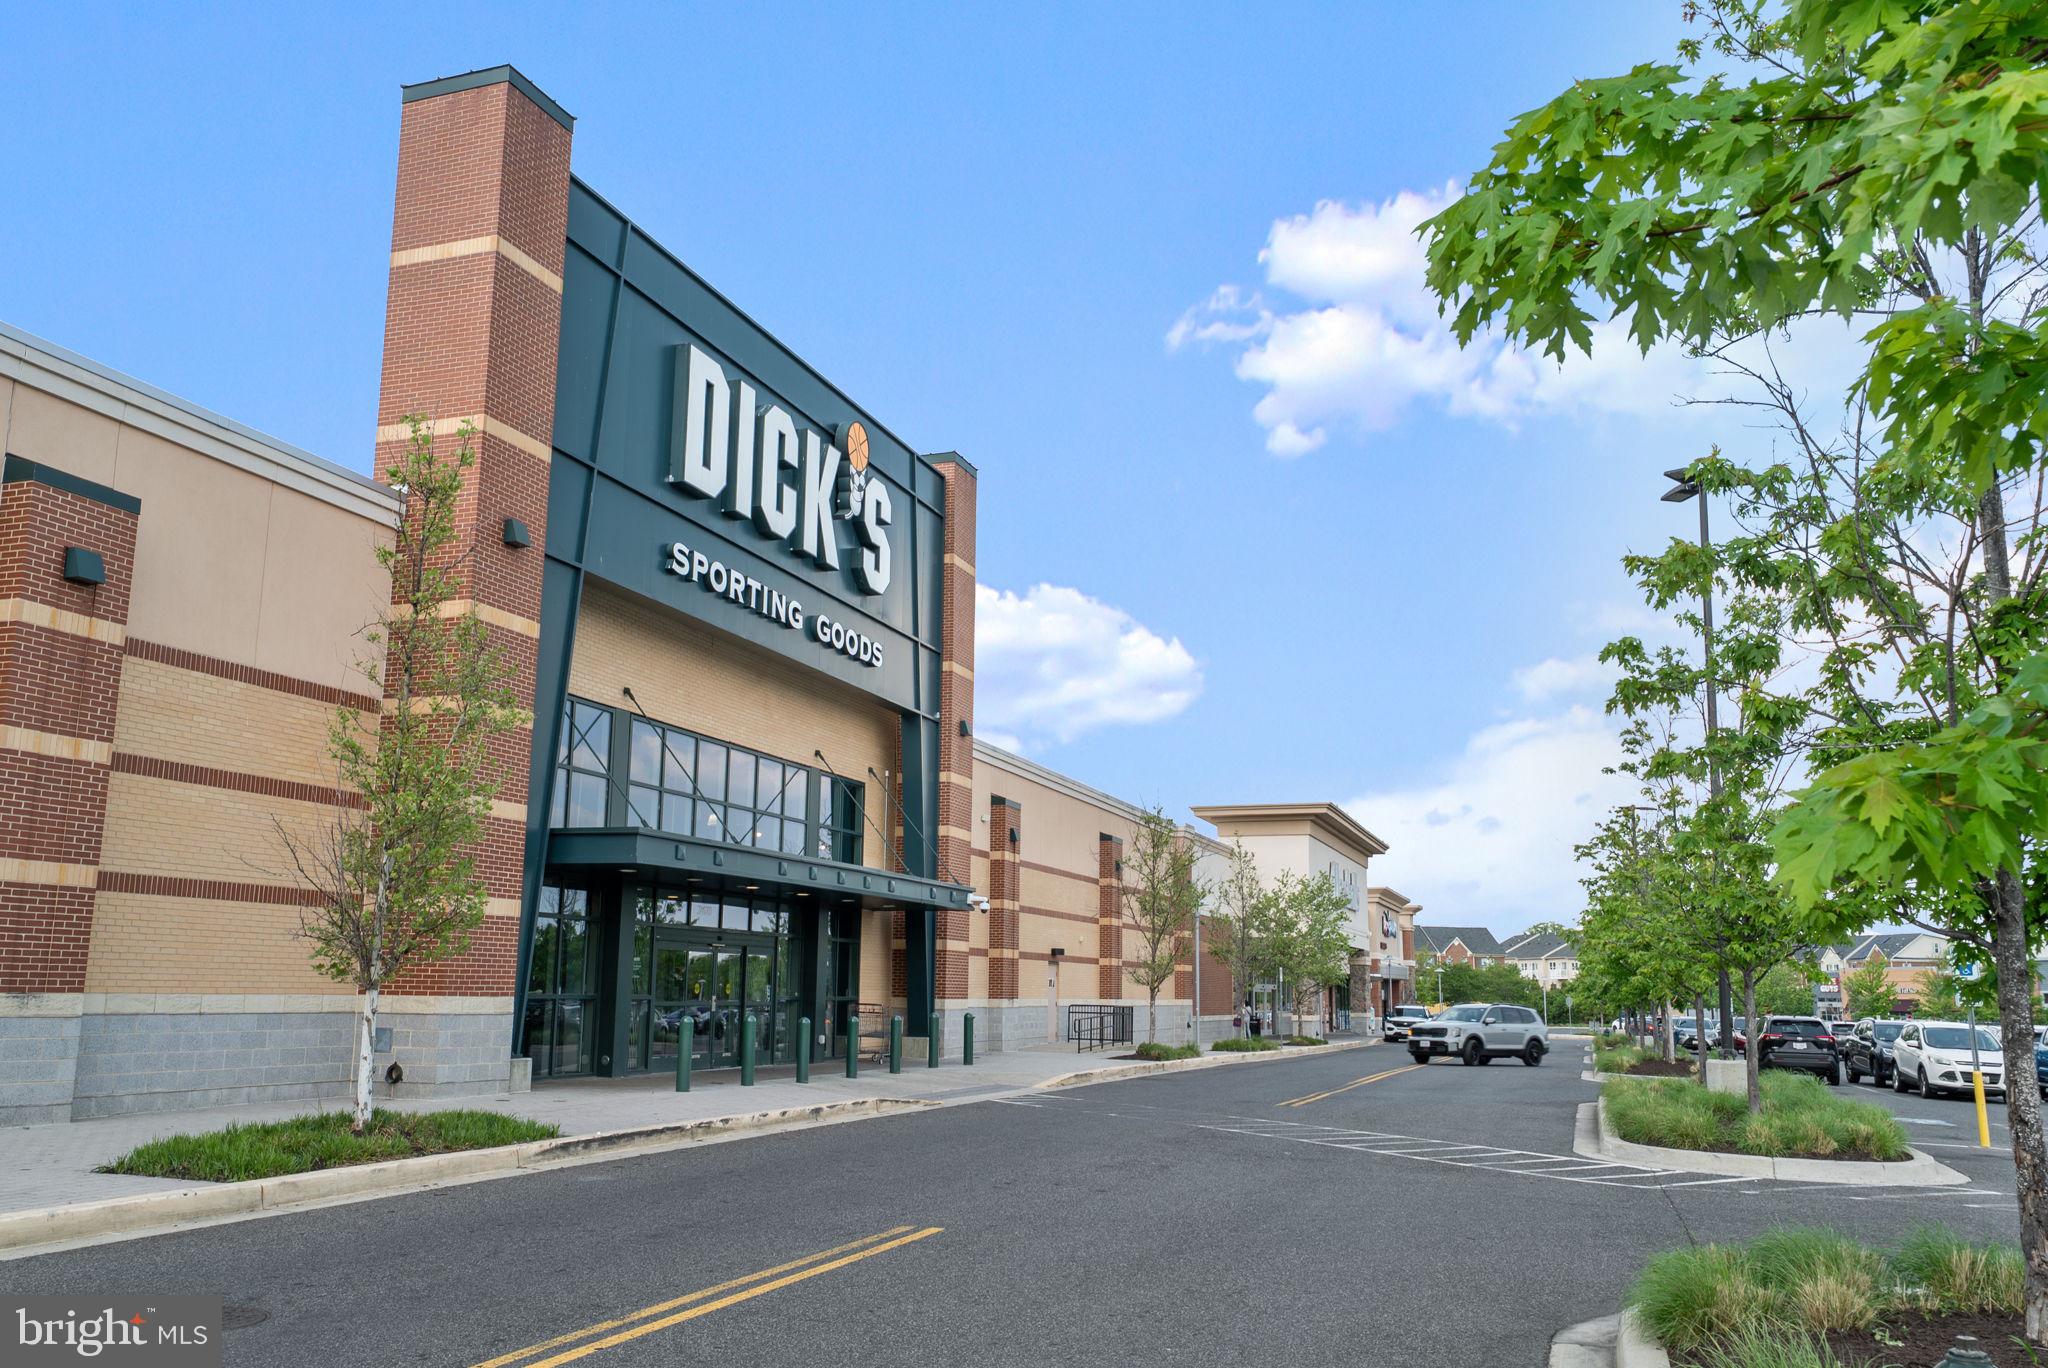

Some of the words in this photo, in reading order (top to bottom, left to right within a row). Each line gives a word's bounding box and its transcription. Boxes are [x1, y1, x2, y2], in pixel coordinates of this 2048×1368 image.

[673, 343, 891, 595] DICK'S
[670, 541, 803, 630] SPORTING
[813, 614, 882, 668] GOODS
